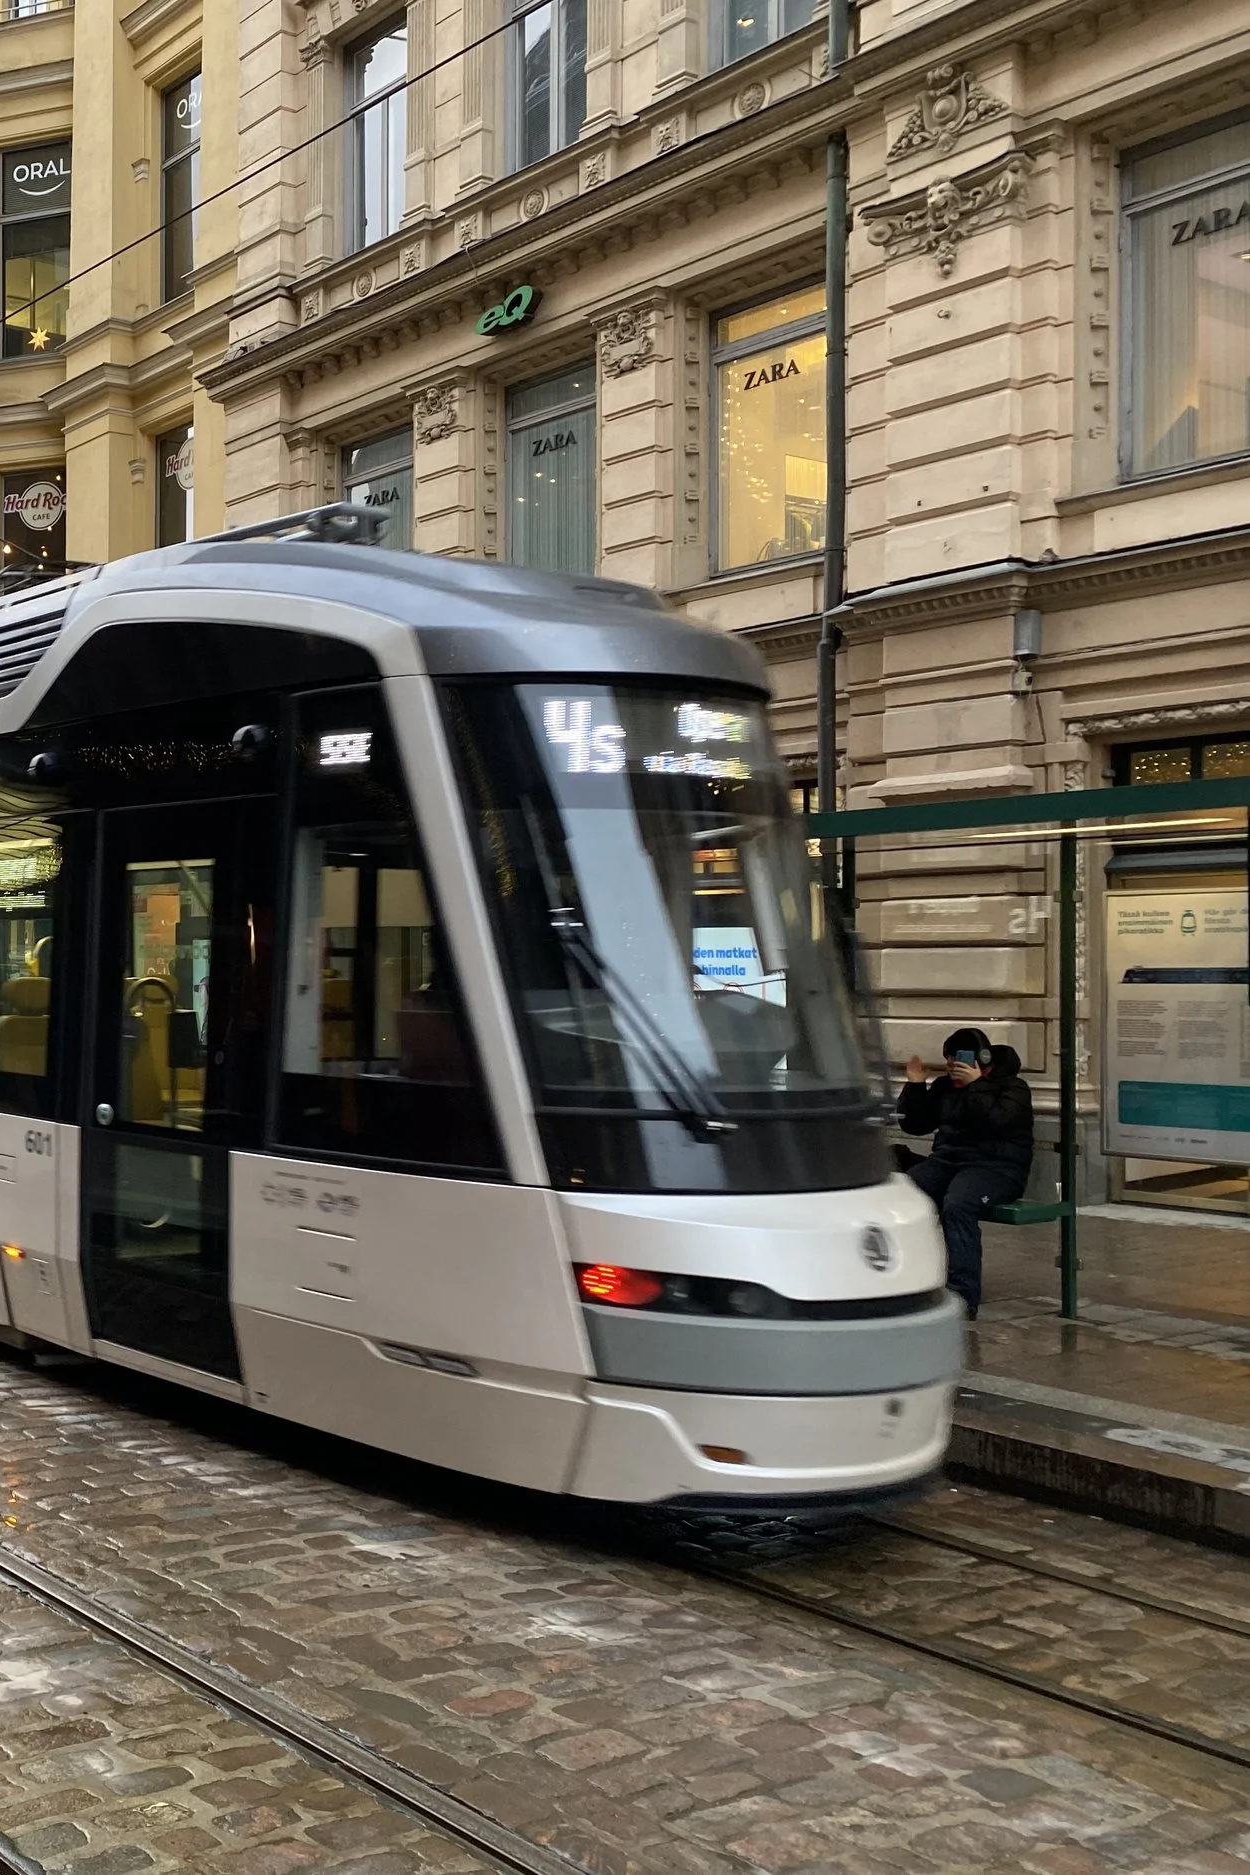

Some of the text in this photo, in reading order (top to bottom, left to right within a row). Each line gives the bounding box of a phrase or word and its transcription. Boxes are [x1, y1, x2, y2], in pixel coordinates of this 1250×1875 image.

[13, 158, 71, 182] ORAL
[474, 285, 537, 336] eQ
[744, 359, 801, 391] ZARA
[532, 430, 577, 457] ZARA
[166, 449, 191, 477] Hard
[5, 493, 41, 512] Hard
[364, 486, 400, 506] ZARA
[32, 513, 50, 521] CAFE
[716, 947, 757, 959] matkat
